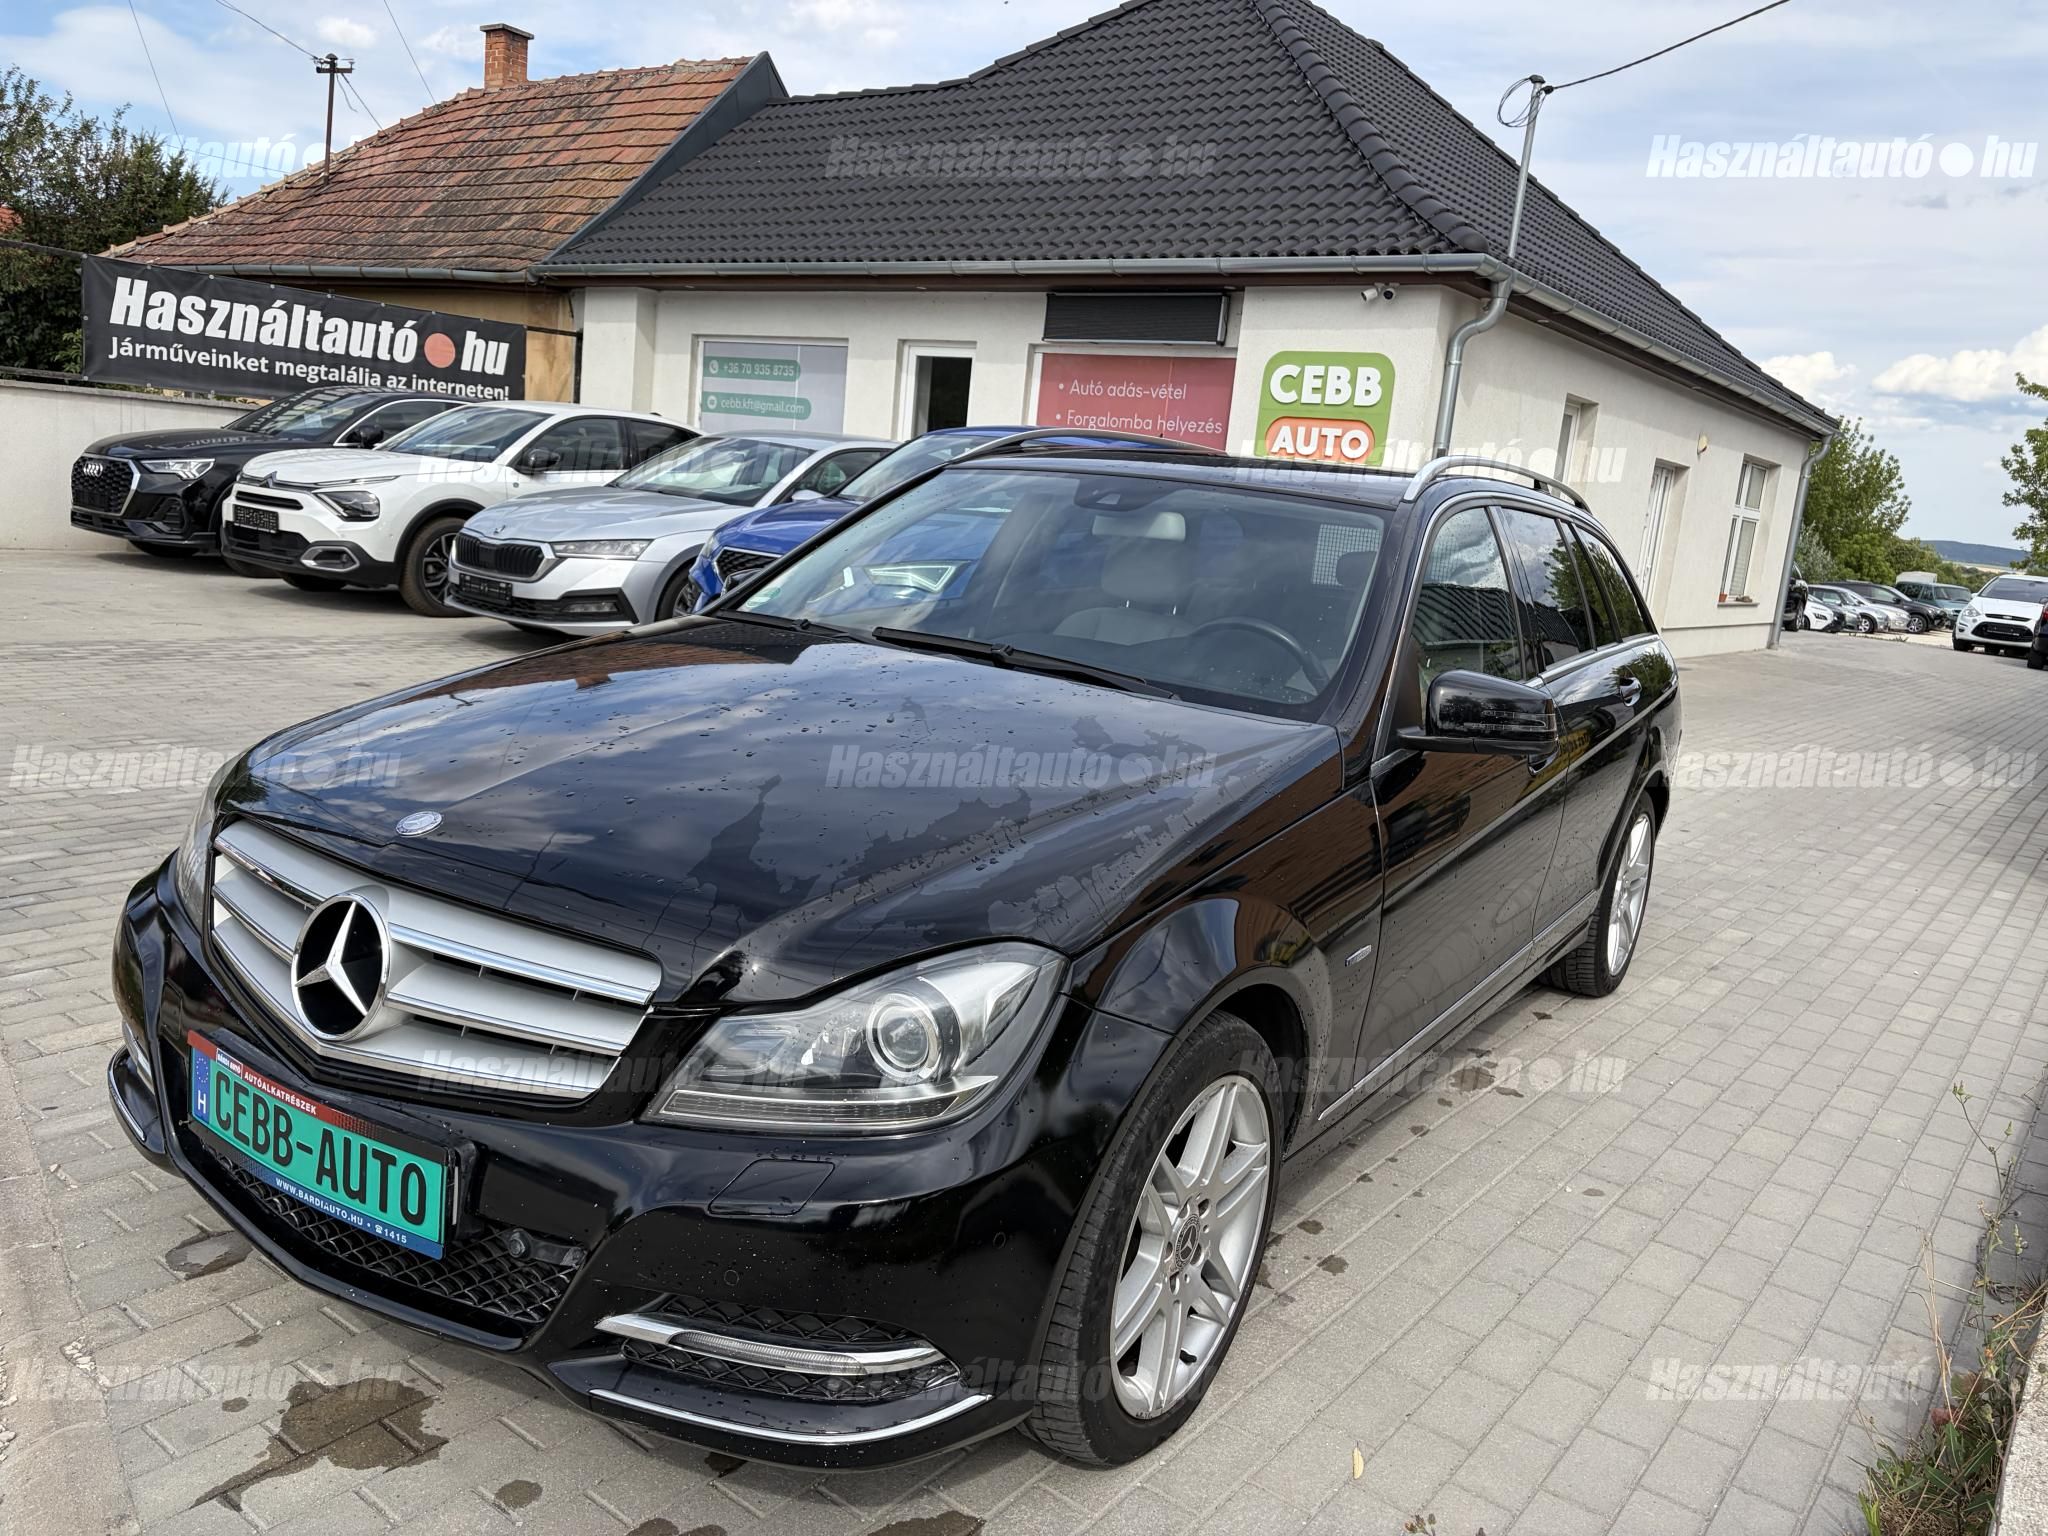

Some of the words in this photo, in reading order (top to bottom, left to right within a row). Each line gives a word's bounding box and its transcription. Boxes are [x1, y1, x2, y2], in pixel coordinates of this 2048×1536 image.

[110, 277, 418, 363] Használtautó
[460, 331, 510, 376] hu
[108, 336, 269, 373] Járműveinket
[275, 359, 382, 388] megtalálja
[386, 374, 407, 389] az
[411, 374, 509, 400] interneten!
[723, 362, 739, 374] +36
[742, 363, 752, 374] 70
[1069, 379, 1103, 396] Autó
[1107, 381, 1187, 400] adás-vétel
[1269, 364, 1383, 407] CEBB
[1067, 409, 1152, 430] Forgalomba
[1157, 414, 1223, 436] helyezés
[1270, 427, 1369, 459] AUTO
[197, 1090, 207, 1114] H
[244, 1071, 317, 1116] AUTÓALKATRÉSZEK
[215, 1070, 428, 1226] CEBB-AUTO
[276, 1177, 364, 1226] WWW.BARDIAUTO.HU
